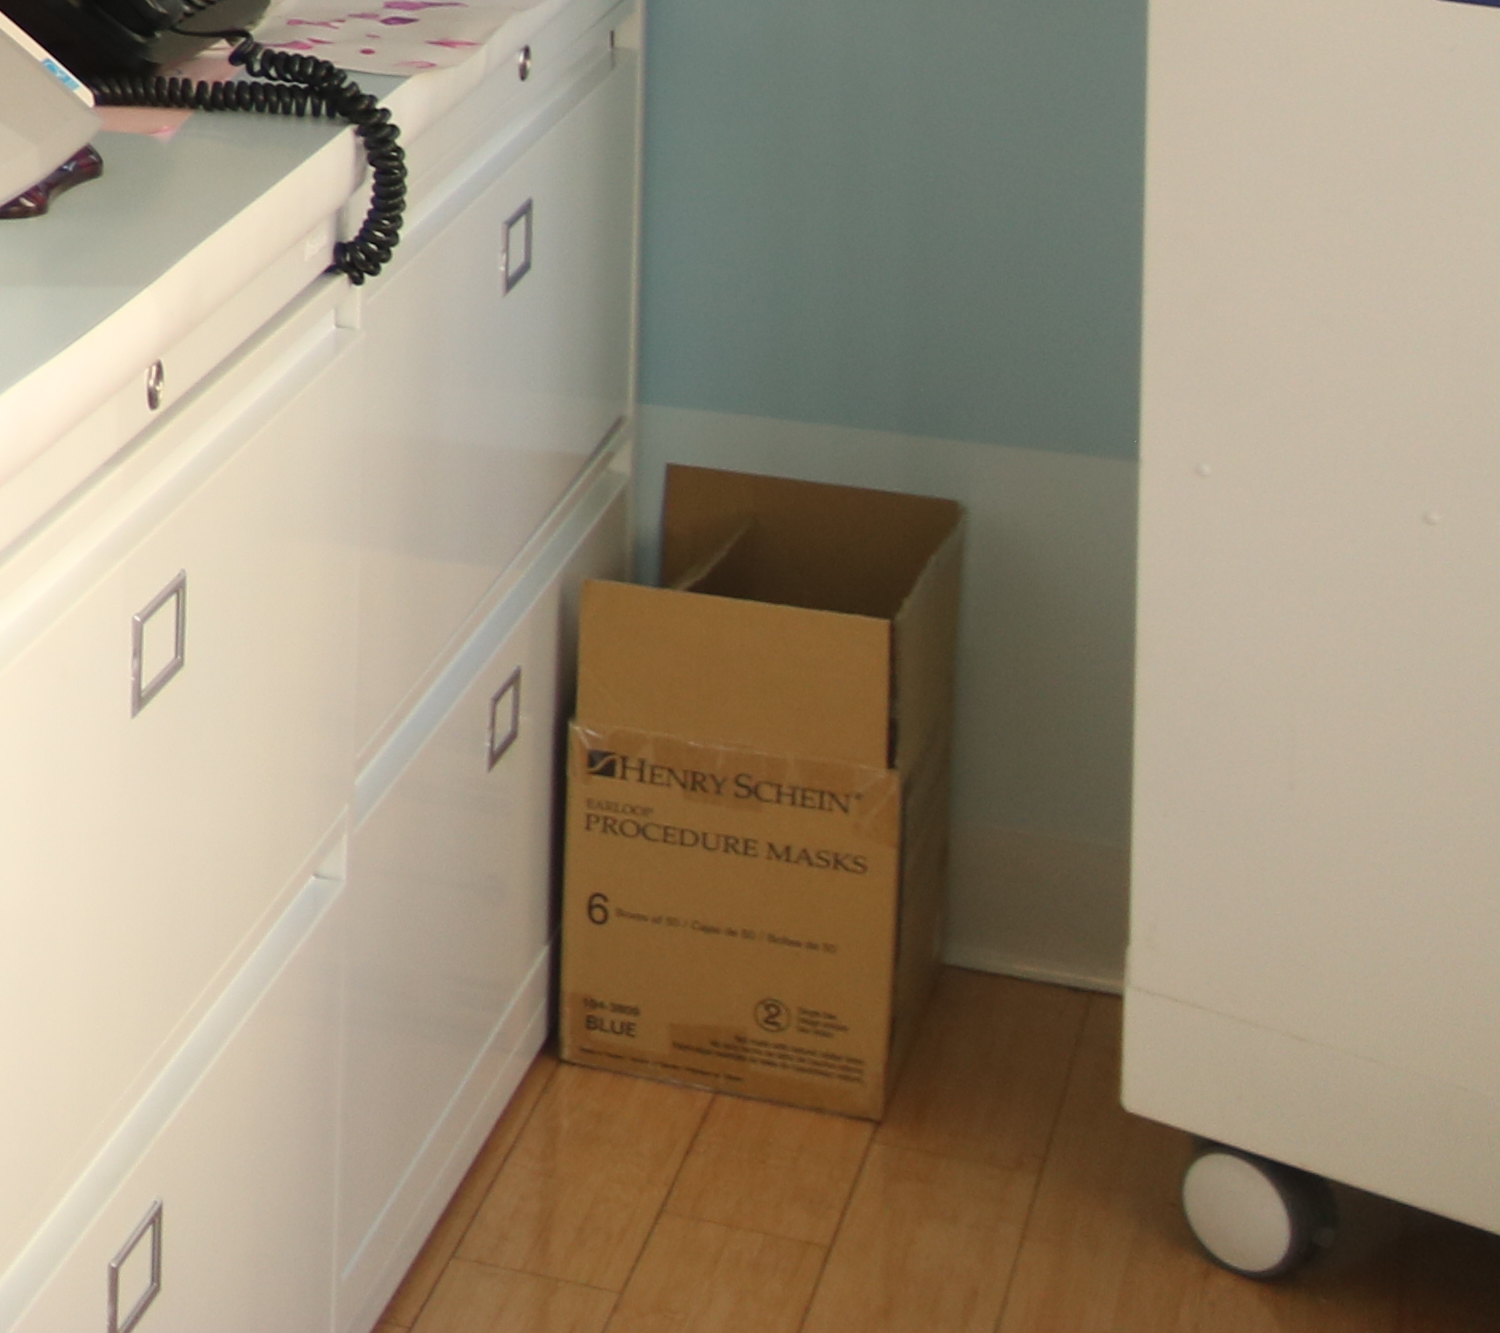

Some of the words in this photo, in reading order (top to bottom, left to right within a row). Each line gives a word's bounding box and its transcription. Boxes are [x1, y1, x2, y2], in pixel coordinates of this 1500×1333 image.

[620, 755, 730, 796] HENRY
[585, 813, 759, 858] PROCEDURE
[766, 842, 868, 874] MASKS
[587, 892, 609, 925] 6
[585, 1014, 636, 1038] BLUE
[763, 1002, 781, 1026] 2
